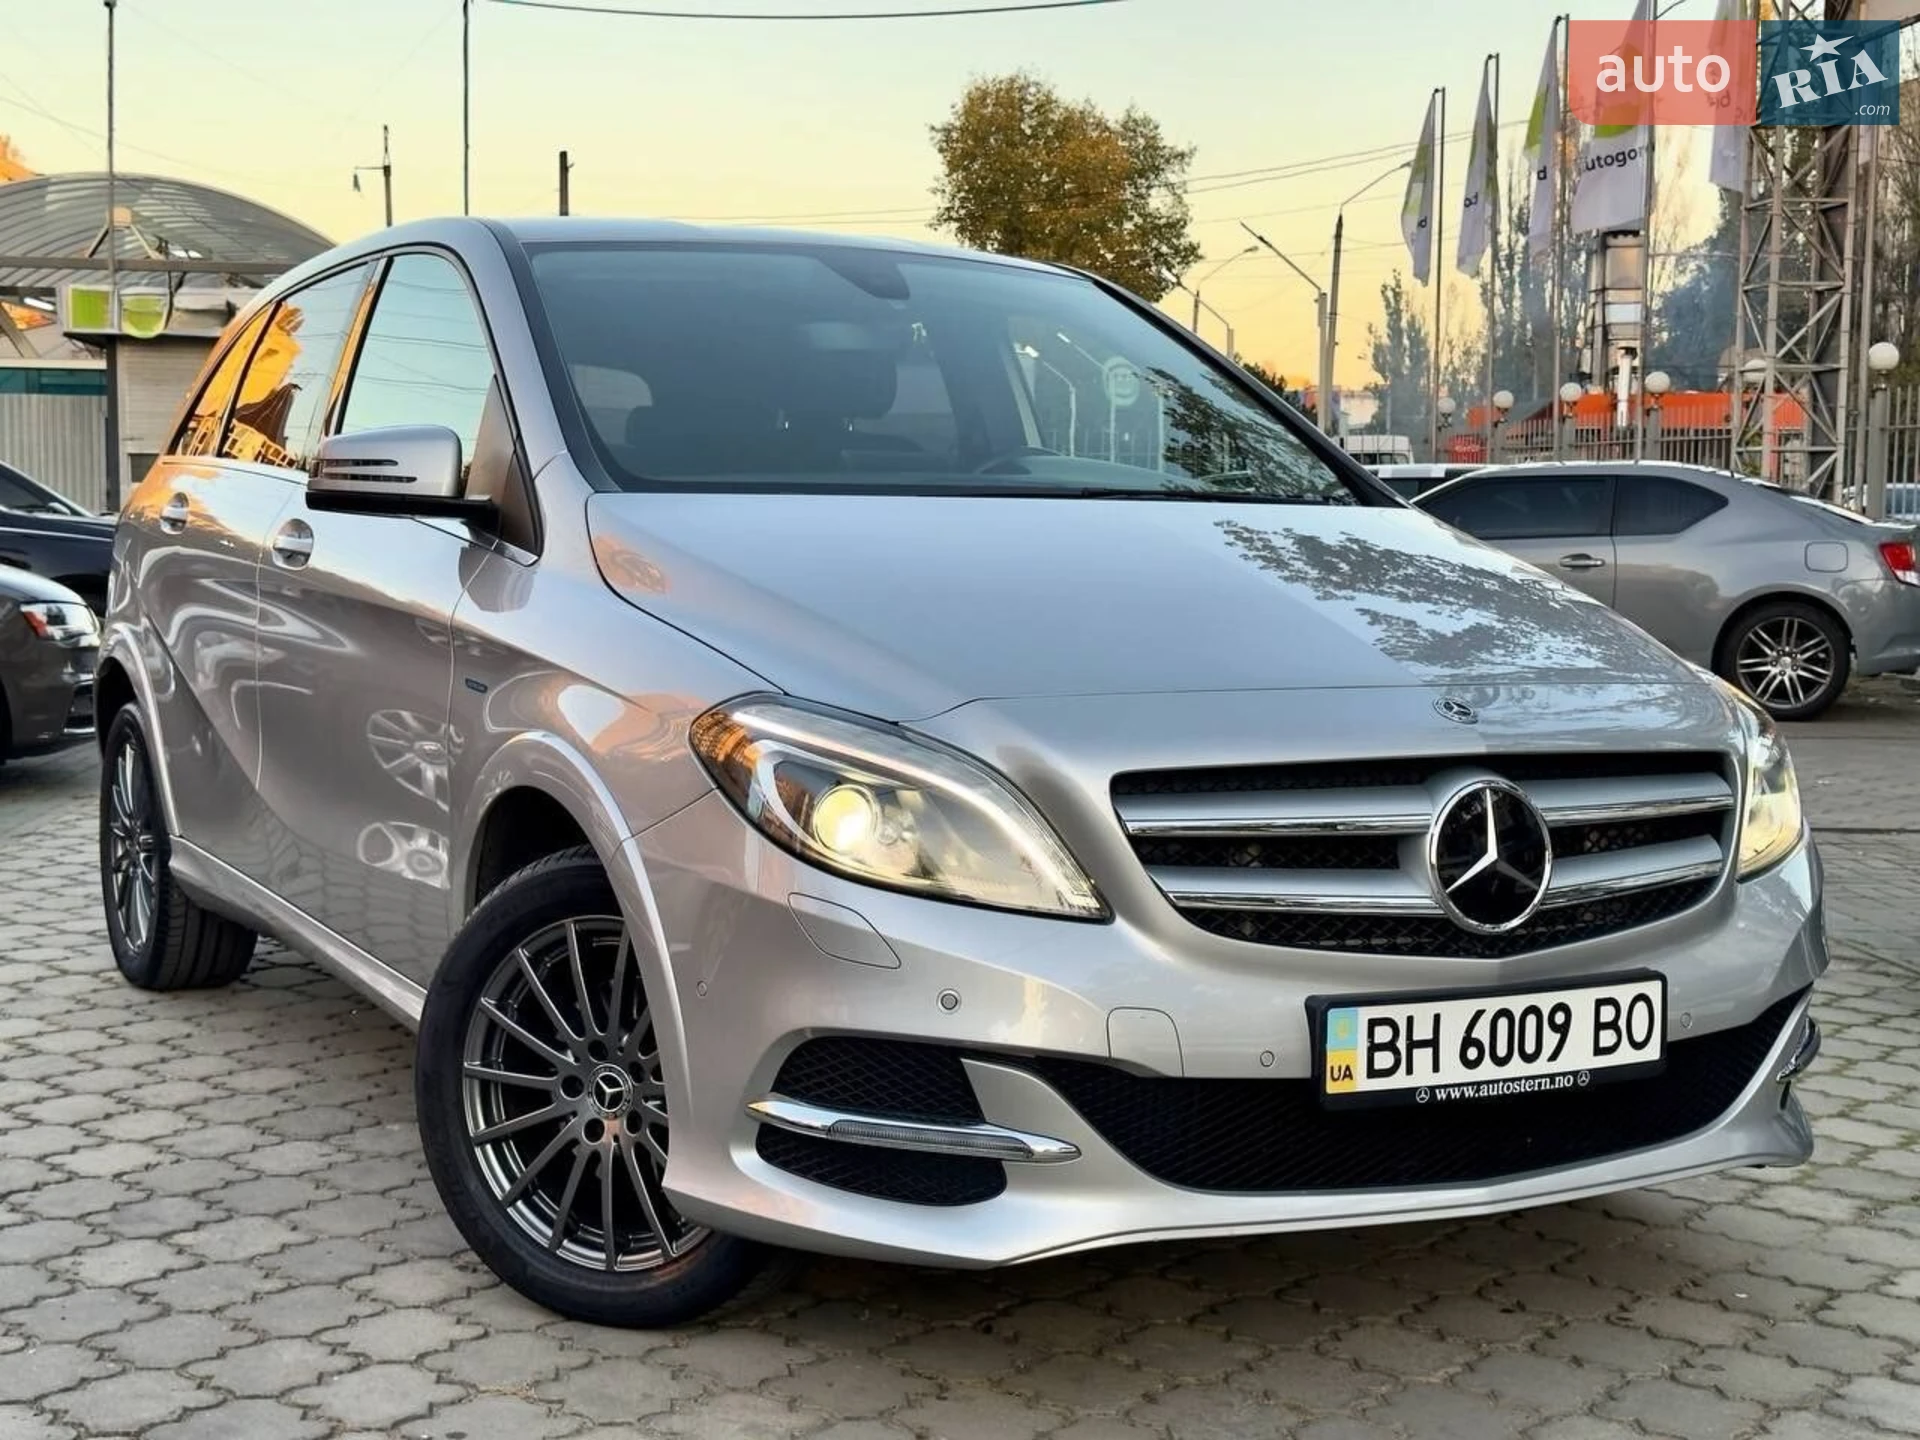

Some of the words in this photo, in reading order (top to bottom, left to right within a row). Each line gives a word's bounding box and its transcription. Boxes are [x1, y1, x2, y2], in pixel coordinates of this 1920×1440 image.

[1366, 1012, 1441, 1080] BH
[1459, 1001, 1573, 1070] 6009
[1593, 992, 1656, 1058] BO
[1330, 1064, 1354, 1083] UA
[1435, 1072, 1574, 1102] www.autostern.no
